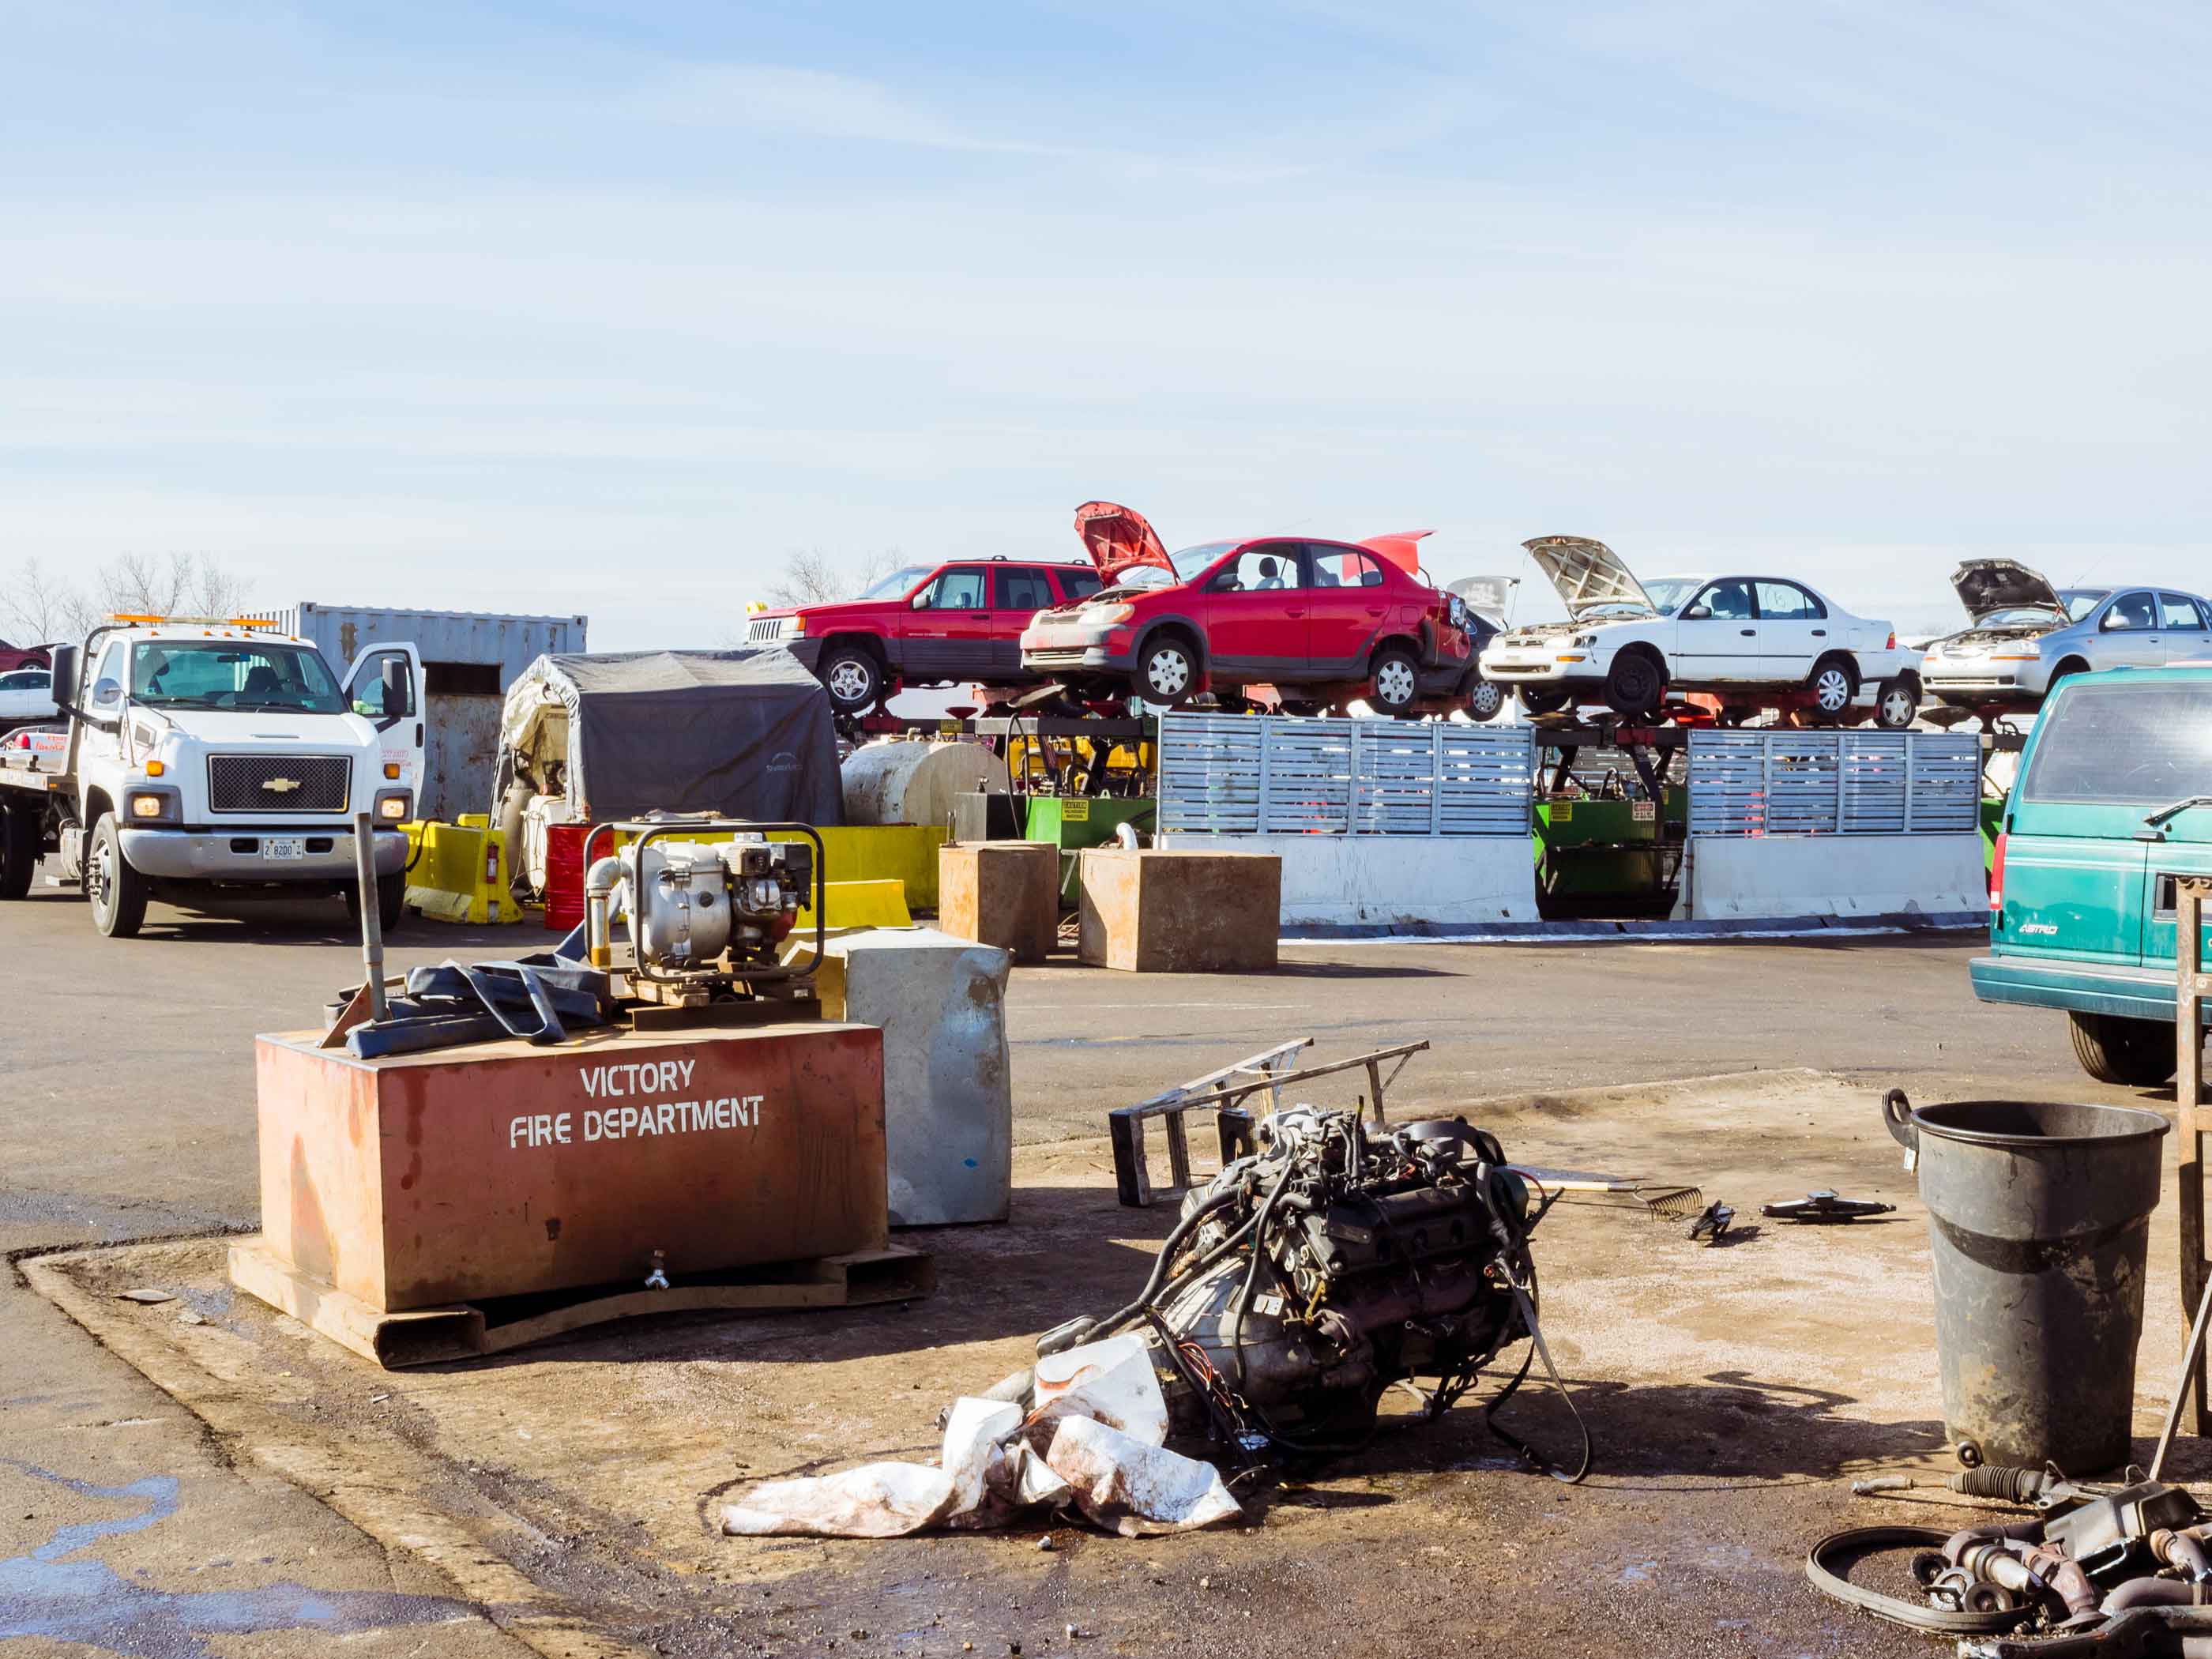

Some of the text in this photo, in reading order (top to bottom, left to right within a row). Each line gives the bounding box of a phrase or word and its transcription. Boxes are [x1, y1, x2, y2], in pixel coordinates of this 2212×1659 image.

[274, 846, 292, 855] 8200
[580, 1059, 696, 1098] VICTORY
[510, 1095, 764, 1149] FIRE DEPARTMENT
